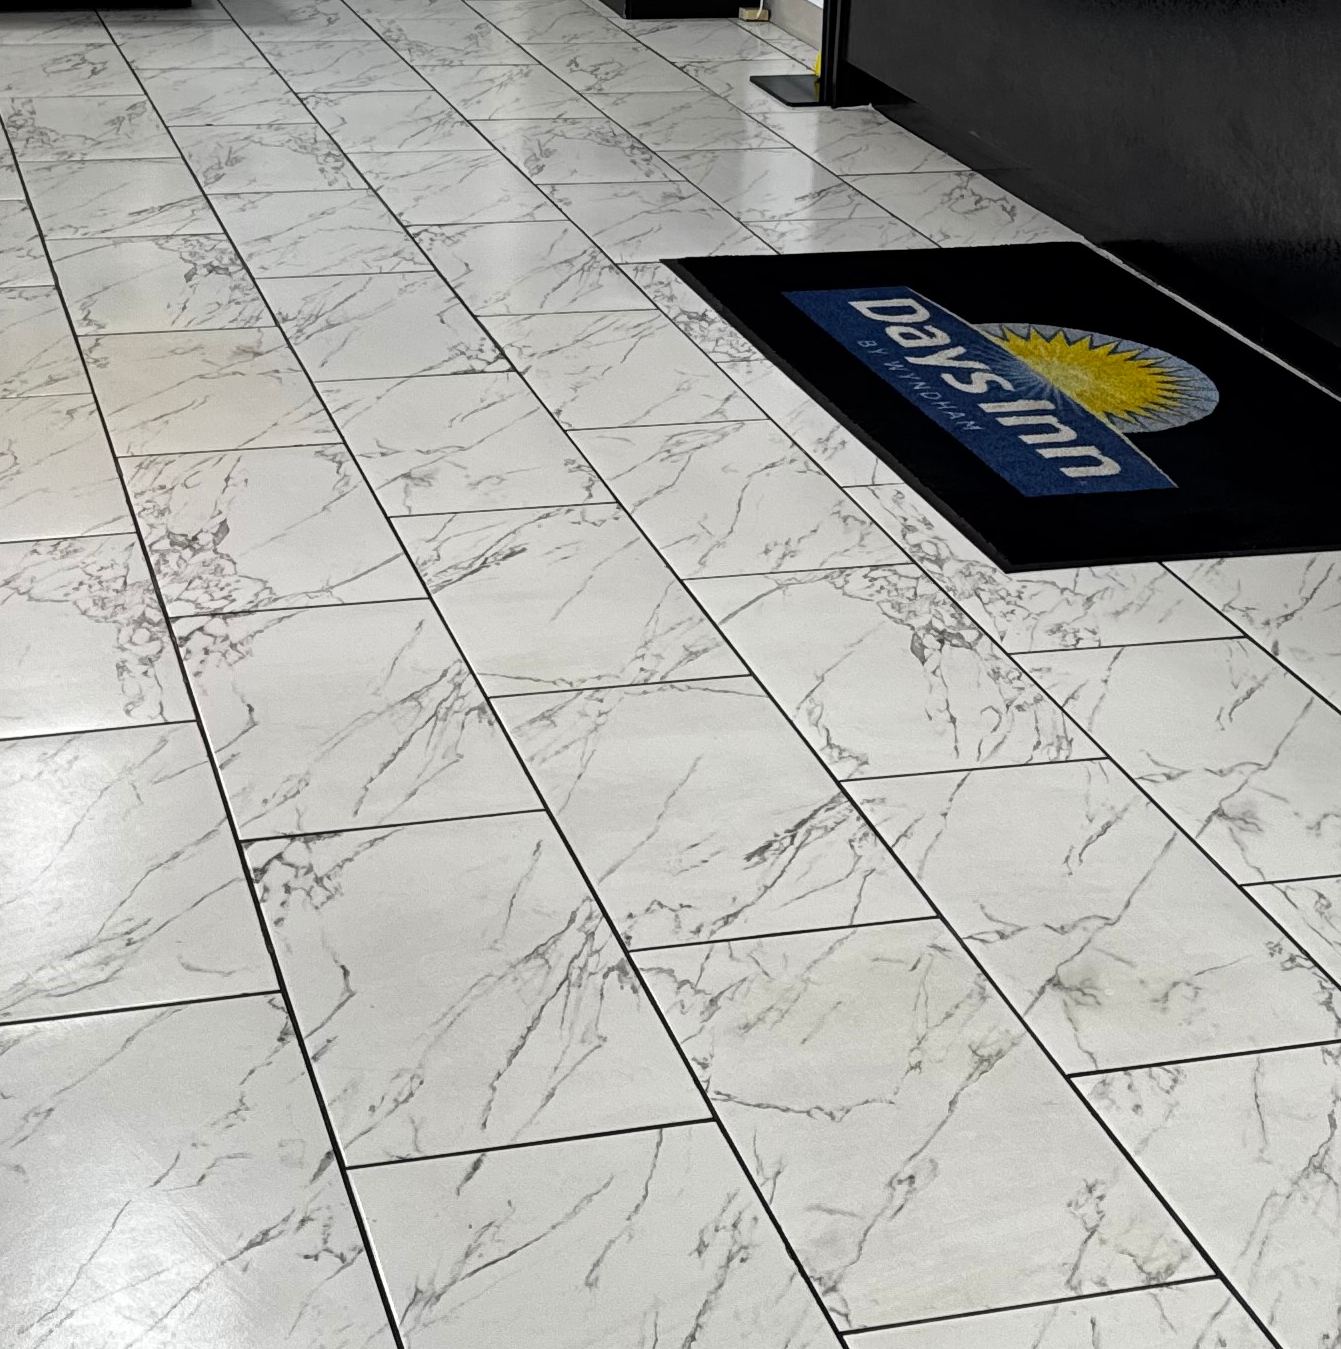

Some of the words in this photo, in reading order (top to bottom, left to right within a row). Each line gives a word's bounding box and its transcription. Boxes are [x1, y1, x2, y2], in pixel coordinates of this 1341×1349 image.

[848, 298, 1015, 394] Days
[977, 399, 1121, 478] Inn
[857, 340, 889, 354] BY
[883, 360, 984, 431] WYNDHAM
